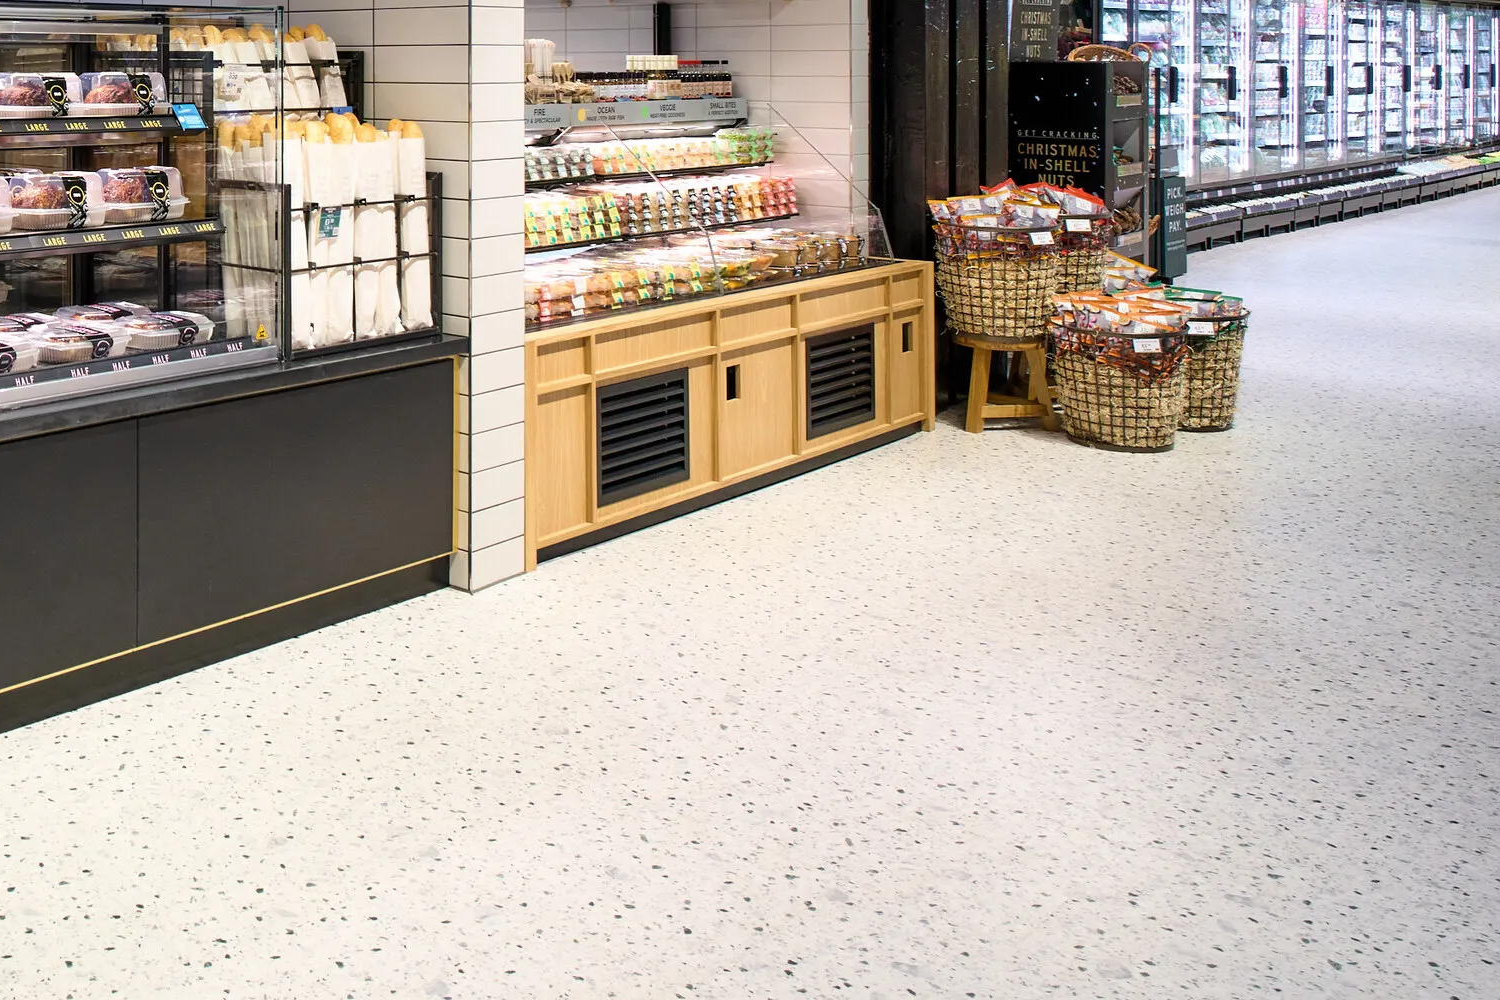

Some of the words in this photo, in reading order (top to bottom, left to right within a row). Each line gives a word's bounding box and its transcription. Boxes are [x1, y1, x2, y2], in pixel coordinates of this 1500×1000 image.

[1020, 11, 1052, 25] CHRISTMAS
[1021, 28, 1048, 41] IN-SHELL
[1026, 45, 1041, 58] NUTS
[25, 123, 50, 132] LARGE
[65, 122, 89, 130] LARGE
[104, 121, 126, 129] LARGE
[140, 120, 163, 128] LARGE
[1017, 129, 1036, 137] GET
[1042, 130, 1097, 139] CRACKING
[1017, 142, 1097, 158] CHRISTMAS
[1024, 158, 1090, 173] IN-SHELL
[1037, 173, 1075, 188] NUTS
[43, 236, 67, 247] LARGE
[83, 233, 106, 243] LARGE
[121, 230, 145, 239] LARGE
[158, 226, 181, 236] LARGE
[195, 223, 216, 232] LARGE
[15, 375, 35, 387] HALF
[70, 366, 90, 378] HALF
[112, 360, 131, 372] HALF
[152, 354, 170, 365] HALF
[191, 348, 208, 359] HALF
[227, 342, 244, 352] HALF
